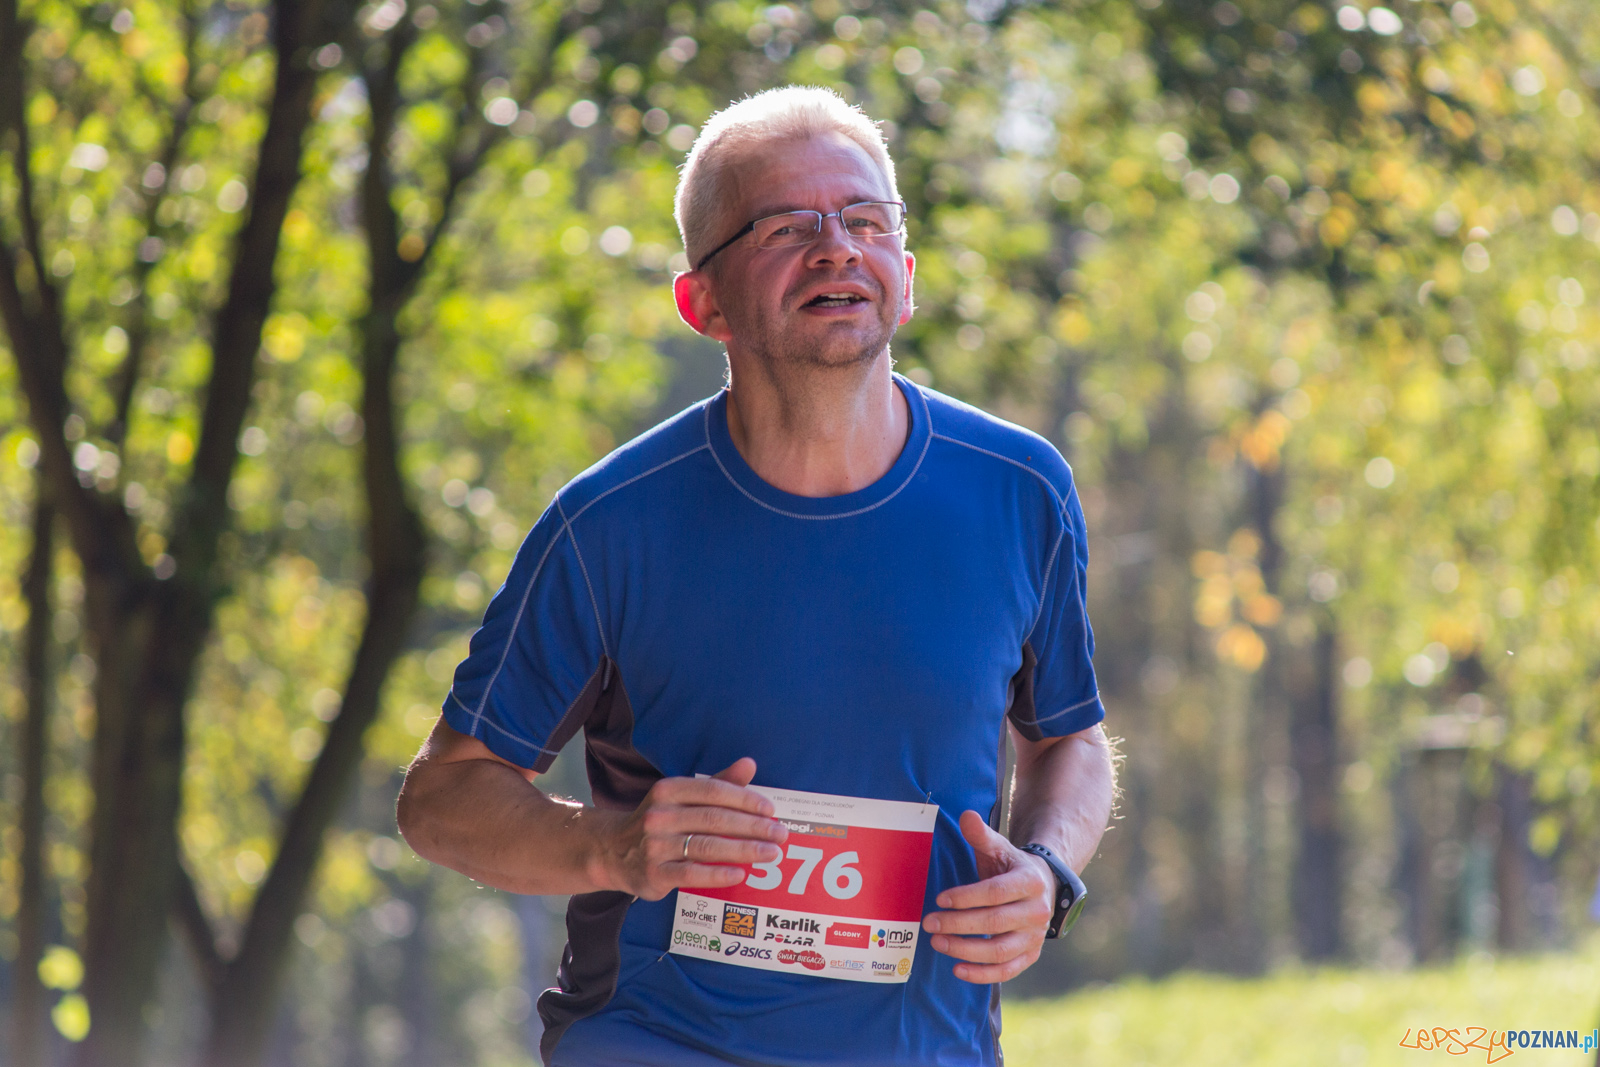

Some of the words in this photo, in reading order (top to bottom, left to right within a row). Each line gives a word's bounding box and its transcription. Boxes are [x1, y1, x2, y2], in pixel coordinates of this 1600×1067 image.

[745, 844, 863, 900] 376
[726, 905, 757, 916] FITNESS
[698, 913, 717, 923] CHIEF
[724, 912, 755, 928] 24
[765, 914, 821, 933] Karlik
[674, 929, 708, 945] green
[723, 925, 754, 937] SEVEN
[889, 929, 914, 943] mjp
[681, 941, 707, 950] PARKING
[763, 932, 814, 947] POLAR
[797, 954, 825, 965] BIEGACZA
[830, 959, 865, 969] etiflex
[871, 961, 897, 972] Rotary
